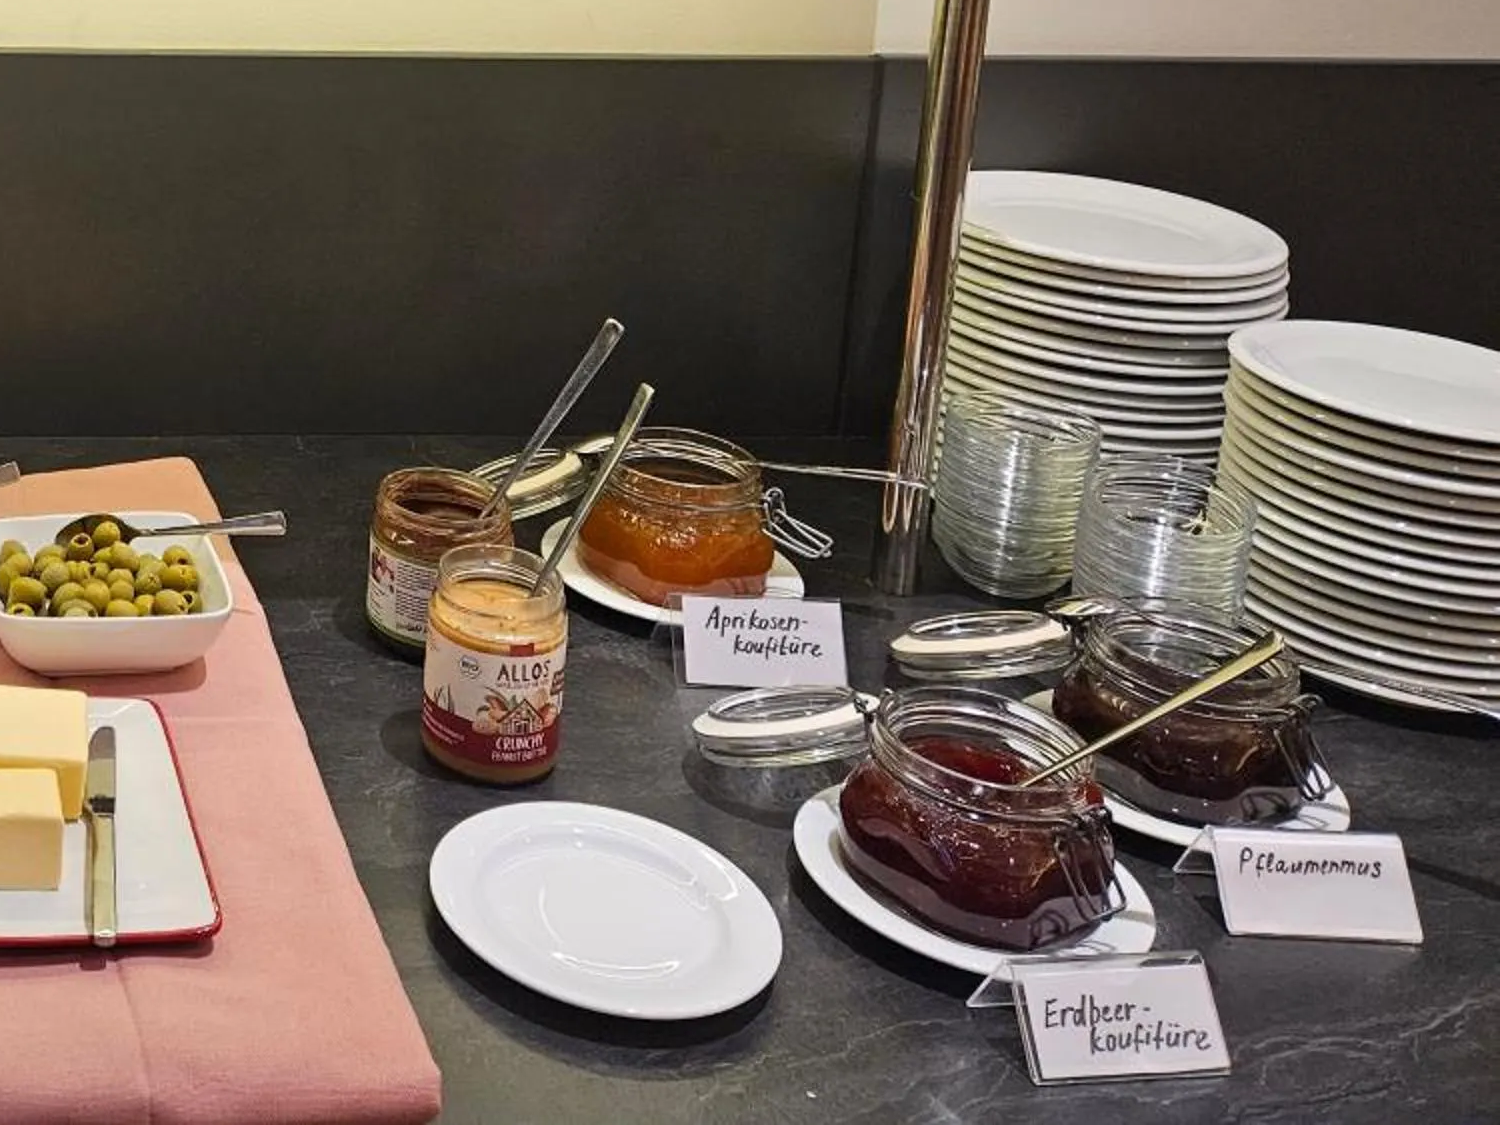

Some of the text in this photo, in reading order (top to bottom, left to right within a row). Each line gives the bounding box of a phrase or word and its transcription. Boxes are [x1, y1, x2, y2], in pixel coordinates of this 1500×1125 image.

[705, 605, 809, 637] Aprikosen-
[497, 659, 552, 682] ALLOS
[1239, 846, 1382, 879] Pflaumenmus
[1045, 994, 1151, 1029] Erdbeer-
